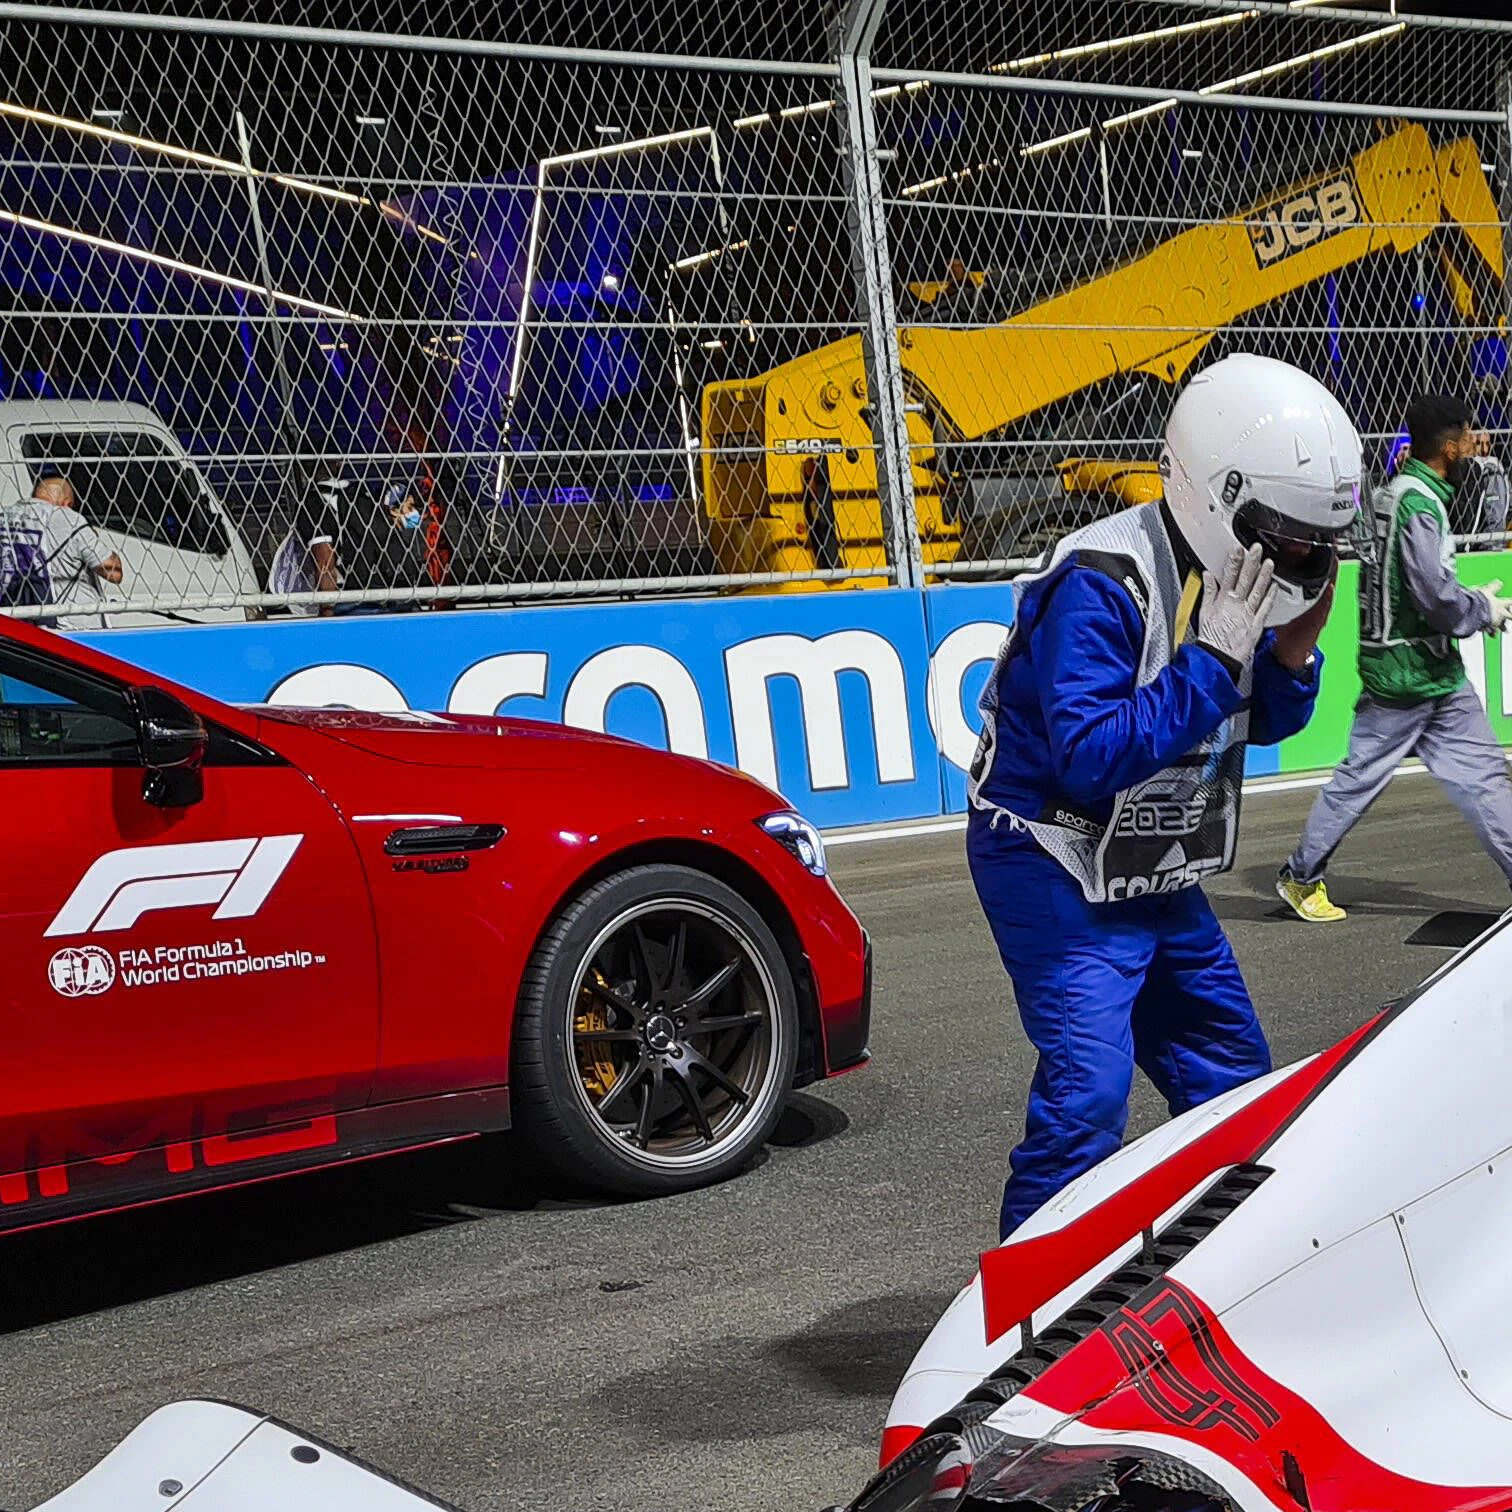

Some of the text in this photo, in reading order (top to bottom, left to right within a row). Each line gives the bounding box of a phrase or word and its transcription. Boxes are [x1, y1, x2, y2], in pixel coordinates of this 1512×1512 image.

[1256, 180, 1358, 261] JCB
[52, 956, 111, 988] FIA
[119, 938, 246, 968] FIA Formula 1
[120, 964, 180, 987] World
[183, 949, 313, 980] Championship
[0, 1082, 337, 1204] MG
